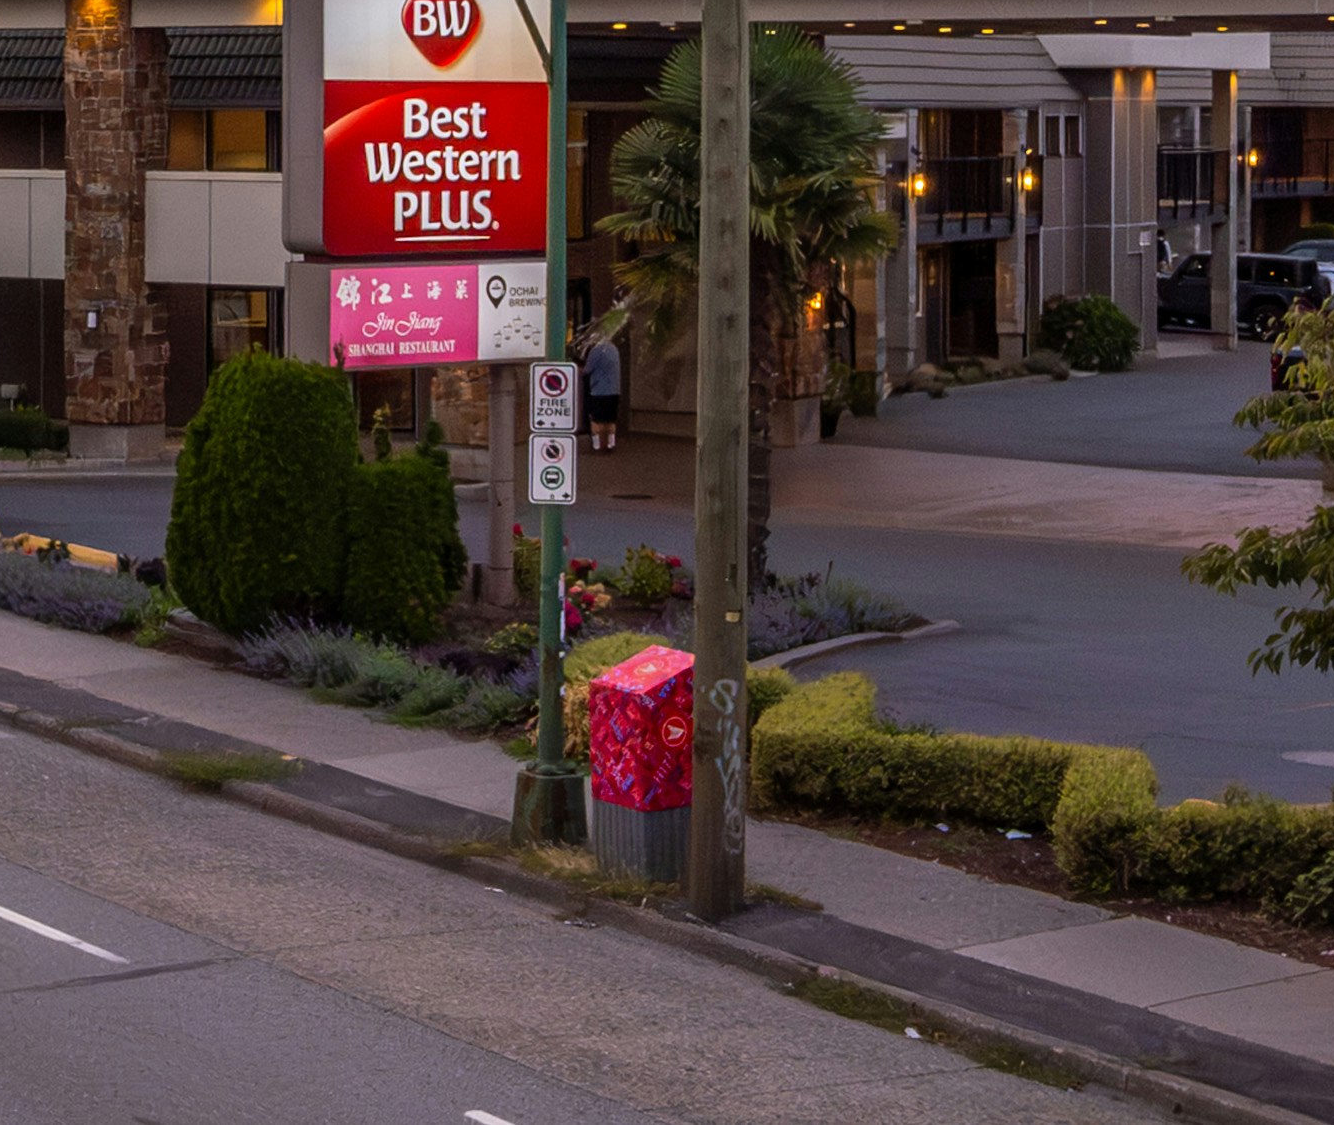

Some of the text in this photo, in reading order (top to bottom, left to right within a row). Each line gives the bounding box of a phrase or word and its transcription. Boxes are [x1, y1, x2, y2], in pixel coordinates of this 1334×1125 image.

[412, 0, 471, 38] BW
[403, 98, 488, 140] Best
[364, 142, 522, 183] Western
[362, 311, 443, 337] Jin Jiang
[348, 340, 456, 357] SHANGHAI RESTAURANT
[537, 407, 571, 417] ZONE
[539, 398, 568, 408] FIRE
